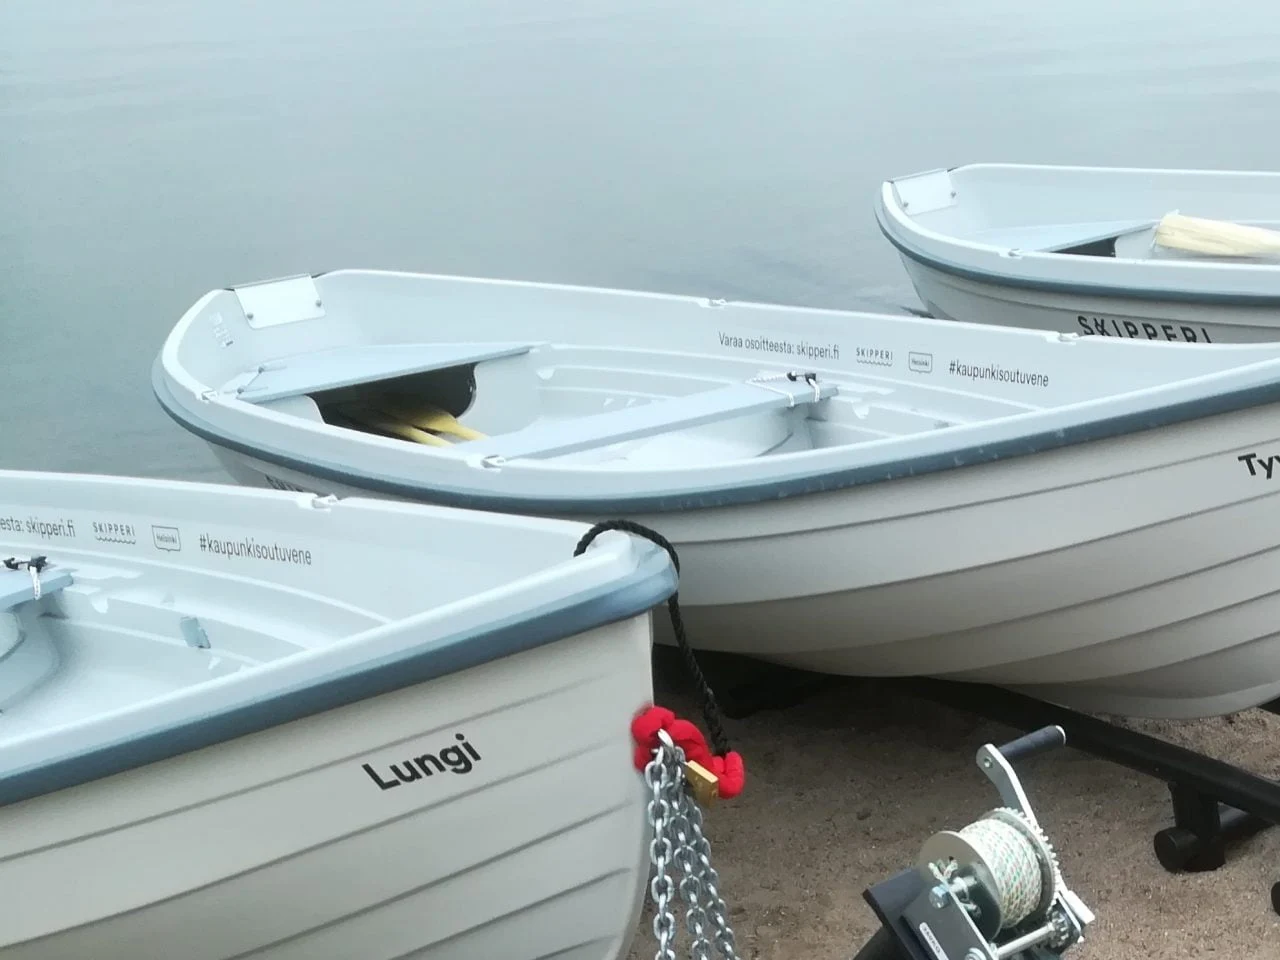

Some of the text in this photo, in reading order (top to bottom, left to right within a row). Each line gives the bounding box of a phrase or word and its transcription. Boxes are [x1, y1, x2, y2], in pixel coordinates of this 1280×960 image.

[718, 331, 840, 360] Varaa osoitteesta: skipperi.fi
[856, 347, 893, 361] SKIPPERI
[949, 360, 1049, 388] #kaupunkisoutuvene
[25, 515, 76, 540] skipperi.fi
[92, 521, 136, 537] SKIPPERI
[199, 532, 312, 566] #kaupunkisoutuvene
[361, 732, 482, 791] Lungi
